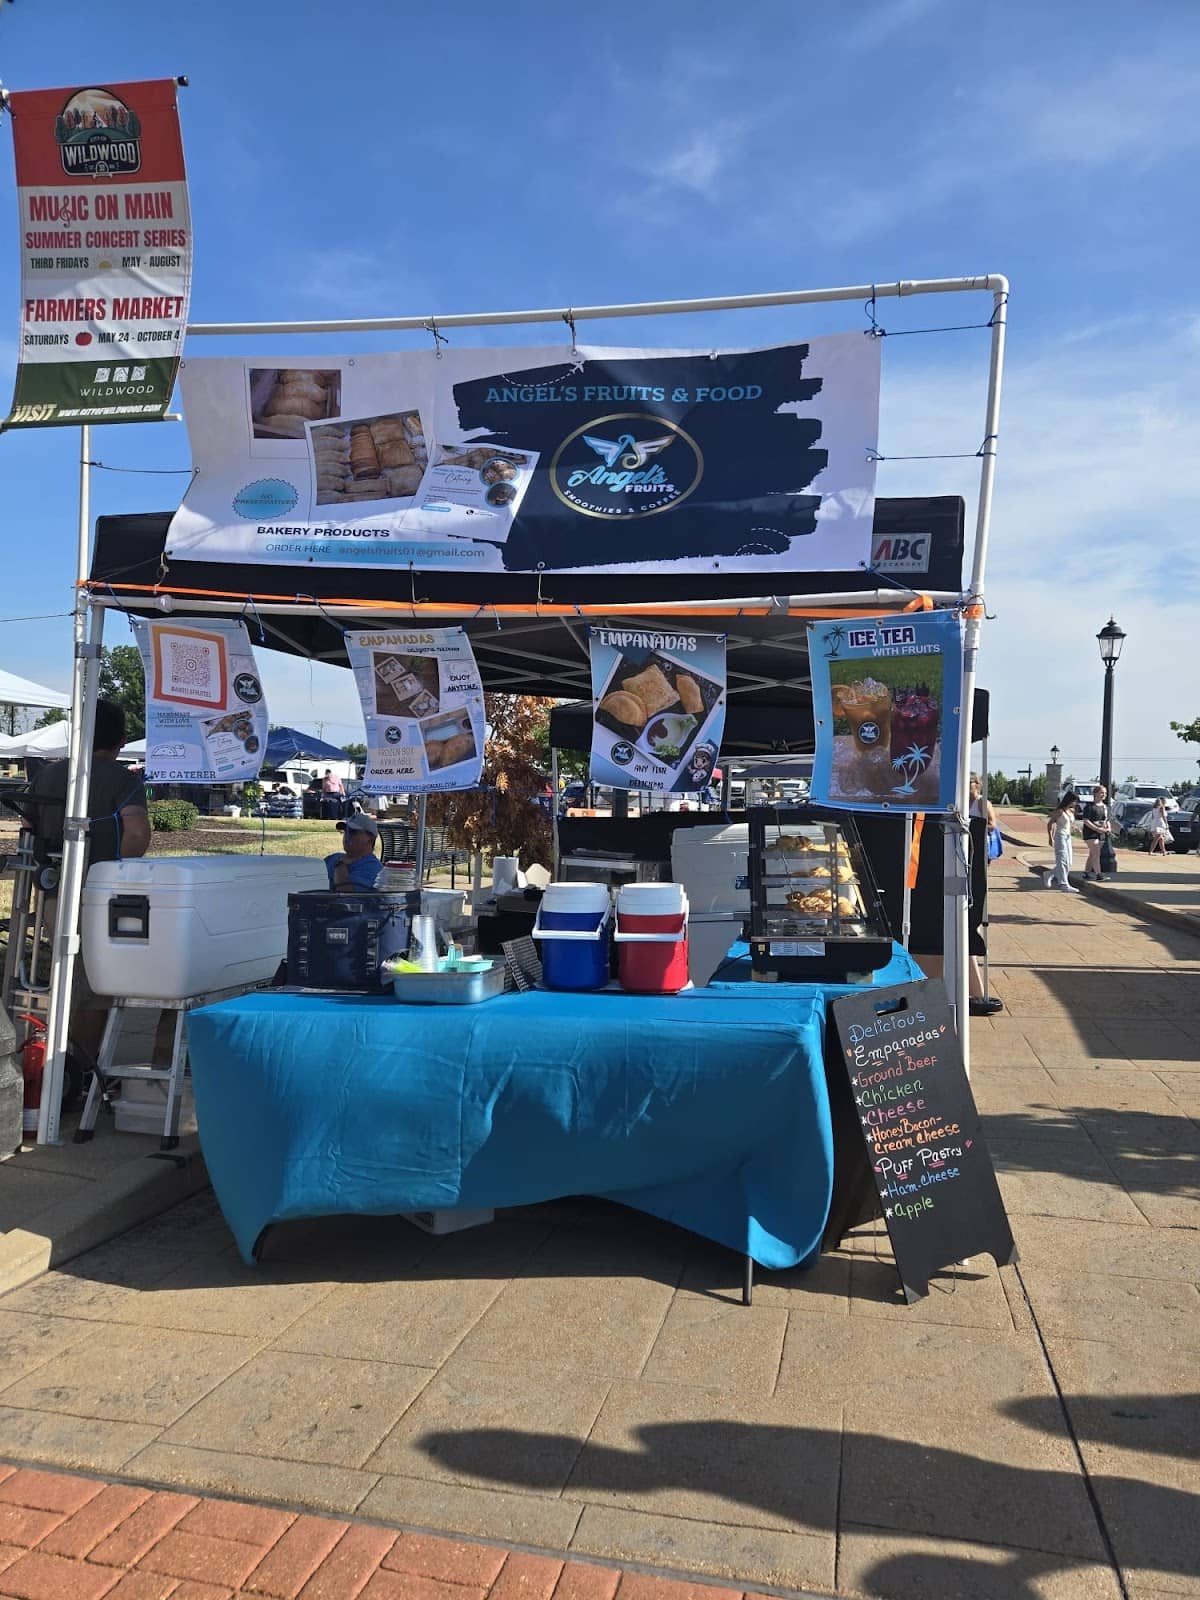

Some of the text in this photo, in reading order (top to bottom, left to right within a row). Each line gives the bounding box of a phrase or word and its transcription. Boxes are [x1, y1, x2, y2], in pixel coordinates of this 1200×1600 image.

[64, 142, 137, 167] WILDWOOD
[94, 195, 119, 220] ON
[125, 192, 173, 219] MAIN
[26, 229, 186, 249] SUMMER CONCERT SERIES
[30, 258, 54, 269] THIRD
[56, 257, 89, 269] FRIDAYS
[122, 256, 140, 268] MAY
[149, 255, 180, 267] AUGUST
[24, 296, 184, 322] FARMERS MARKET
[24, 334, 69, 346] SATURDAYS
[98, 332, 115, 344] MAY
[117, 332, 129, 342] 24
[137, 330, 172, 342] OCTOBER
[173, 330, 180, 341] 4
[80, 385, 154, 397] WILDWOOD
[485, 385, 763, 403] ANGEL'S FRUITS & FOOD
[11, 403, 57, 421] VISIT
[567, 464, 669, 493] Angel's
[624, 484, 675, 493] FRUITS
[563, 490, 622, 514] SMOOTHIES
[641, 490, 682, 512] COFFEE
[257, 526, 390, 538] BAKERY PRODUCTS
[265, 543, 300, 553] ORDER
[304, 544, 331, 554] HERE
[873, 538, 926, 561] ABC
[360, 634, 435, 647] EMPANADAS
[600, 631, 697, 651] EMPANADAS
[848, 626, 915, 648] ICE TEA
[872, 644, 941, 657] WITH FRUITS
[150, 771, 217, 779] WE CATERER
[370, 767, 394, 775] ORDER
[848, 1011, 926, 1044] Delicious
[854, 1030, 940, 1066] Empanadas
[858, 1055, 938, 1088] Ground Beef
[861, 1079, 924, 1108] Chicken
[867, 1099, 927, 1126] Cheese
[874, 1138, 916, 1155] Cream
